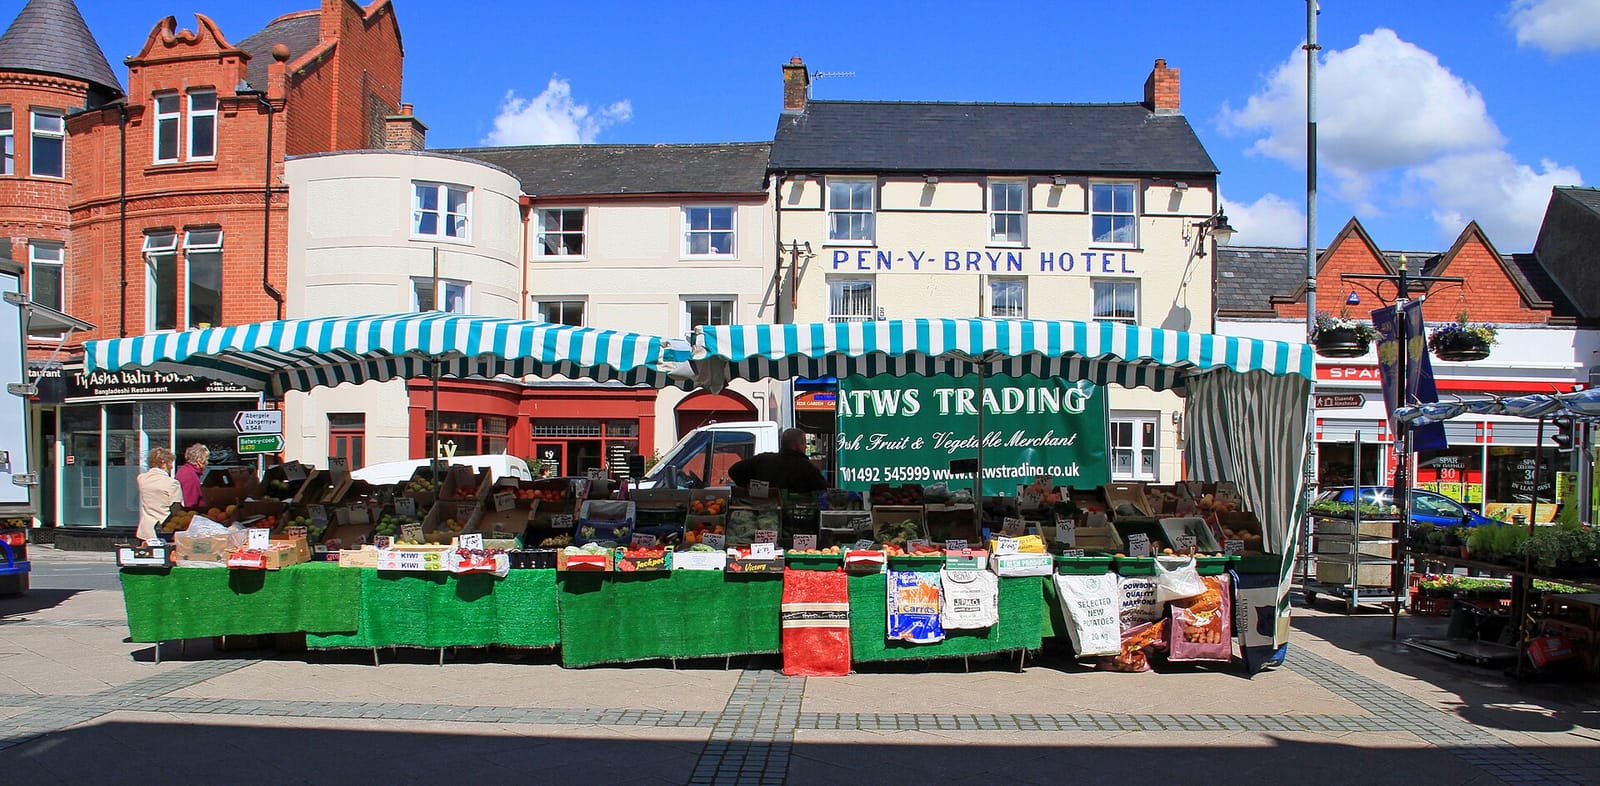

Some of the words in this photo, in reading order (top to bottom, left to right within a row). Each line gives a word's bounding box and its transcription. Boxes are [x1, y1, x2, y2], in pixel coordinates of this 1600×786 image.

[832, 250, 1023, 273] PEN-Y-BRYN
[1040, 251, 1135, 273] HOTEL
[94, 387, 130, 396] Bangladeshi
[131, 386, 168, 394] Restaurant
[933, 386, 1086, 415] TRADING
[865, 433, 911, 451] Fruit
[911, 437, 925, 451] &
[931, 431, 1002, 455] Vegetable
[1003, 429, 1078, 448] Merchant
[1439, 456, 1459, 464] SPAR
[884, 466, 930, 482] 545999
[1440, 468, 1456, 479] 30
[636, 557, 665, 570] Jackpot
[1077, 597, 1111, 609] SELECTED
[1087, 608, 1104, 617] NEW
[1083, 616, 1114, 627] POTATOES
